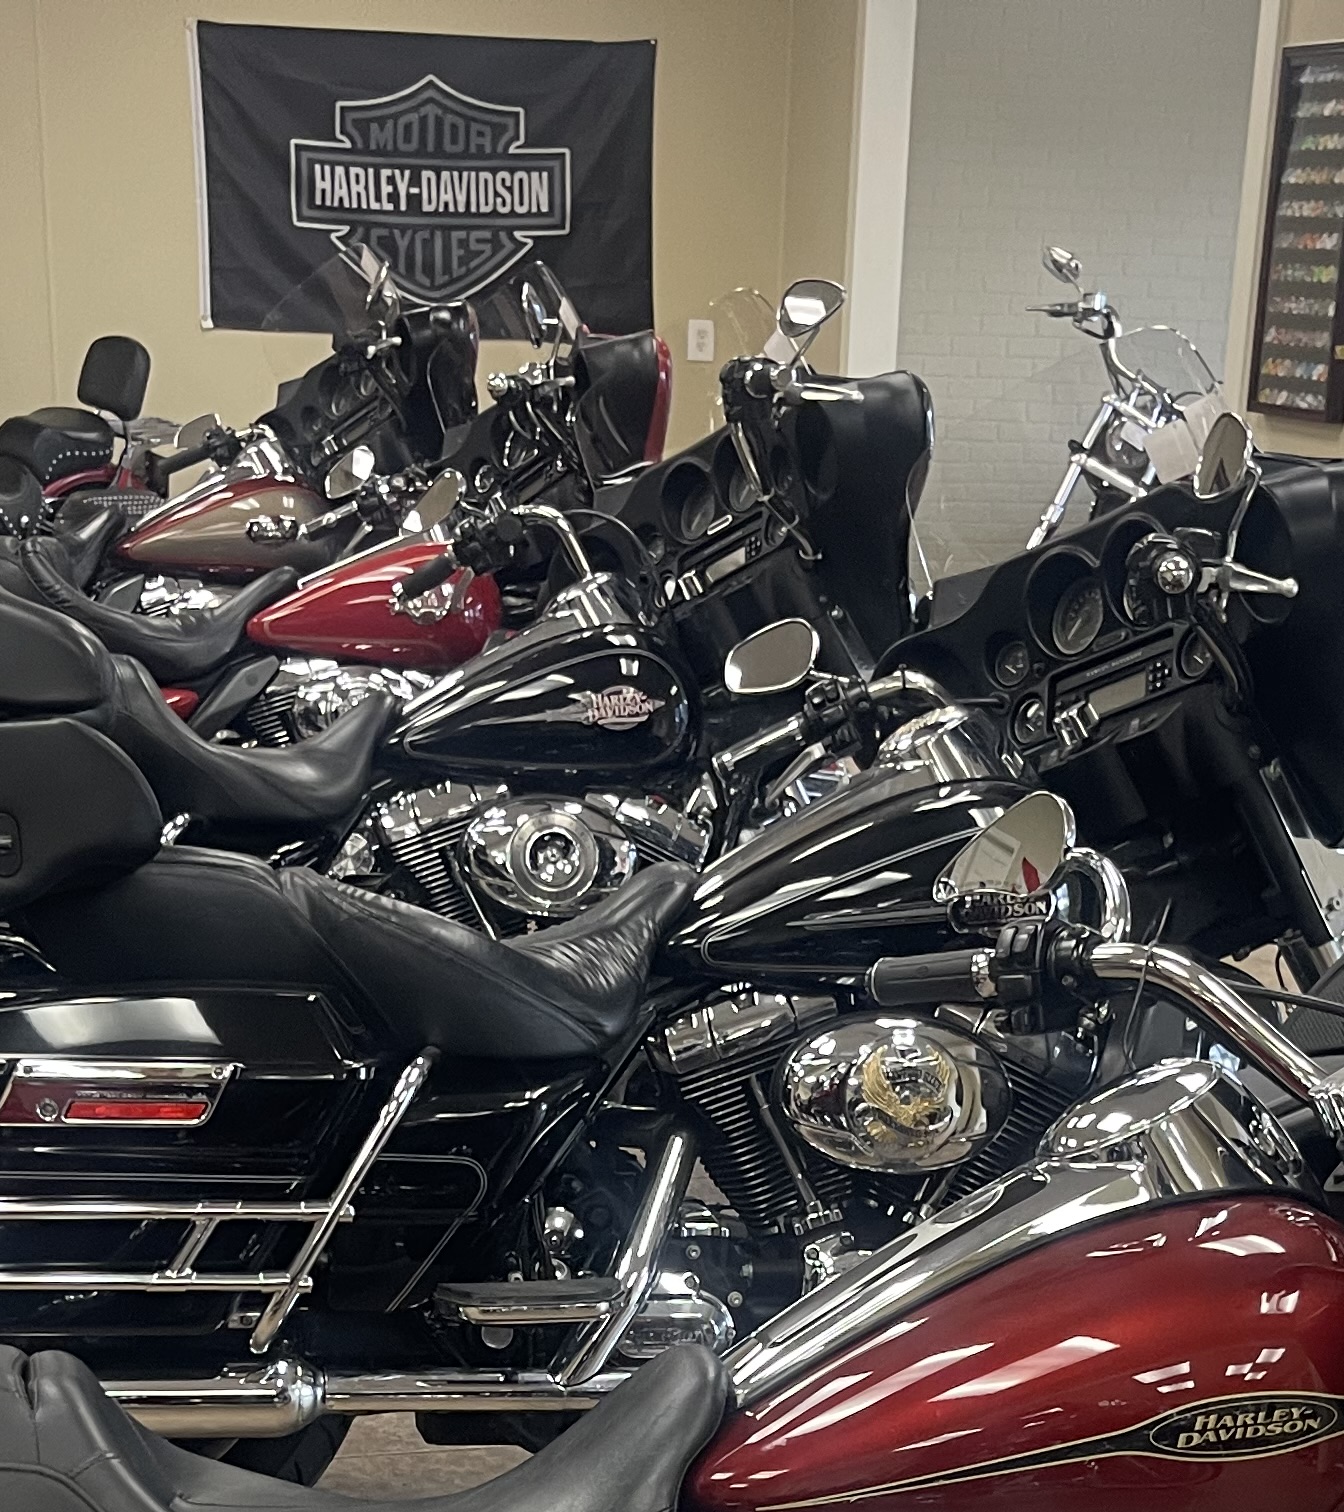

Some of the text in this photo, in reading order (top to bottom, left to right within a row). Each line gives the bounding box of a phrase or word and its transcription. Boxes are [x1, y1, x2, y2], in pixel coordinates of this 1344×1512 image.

[369, 102, 492, 153] MOTOR
[313, 163, 550, 214] HARLEY-DAVIDSON
[369, 227, 493, 287] CYCLES
[587, 700, 654, 721] DAVIDSON
[1176, 1416, 1322, 1449] DAVIDSON
[1193, 1406, 1314, 1431] HARLEY-
